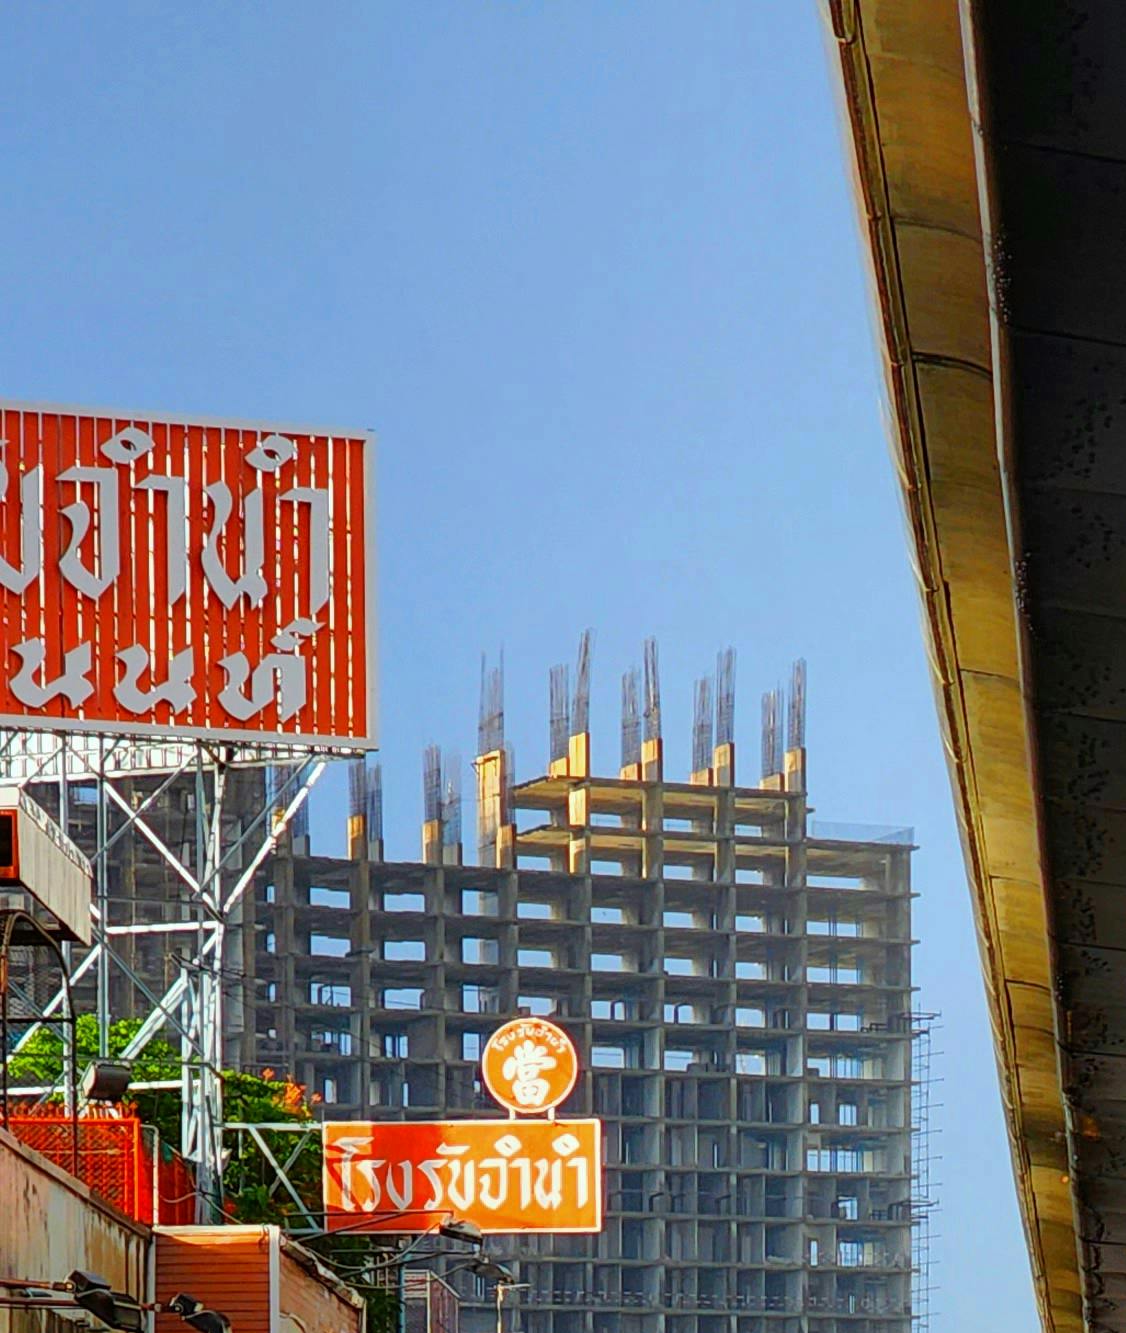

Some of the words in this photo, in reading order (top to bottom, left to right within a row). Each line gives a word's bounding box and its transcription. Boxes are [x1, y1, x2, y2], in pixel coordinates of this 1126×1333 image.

[0, 427, 331, 614] บจำนำ
[502, 1039, 557, 1106] 當
[332, 1134, 589, 1213] โรงรับจำนำ
